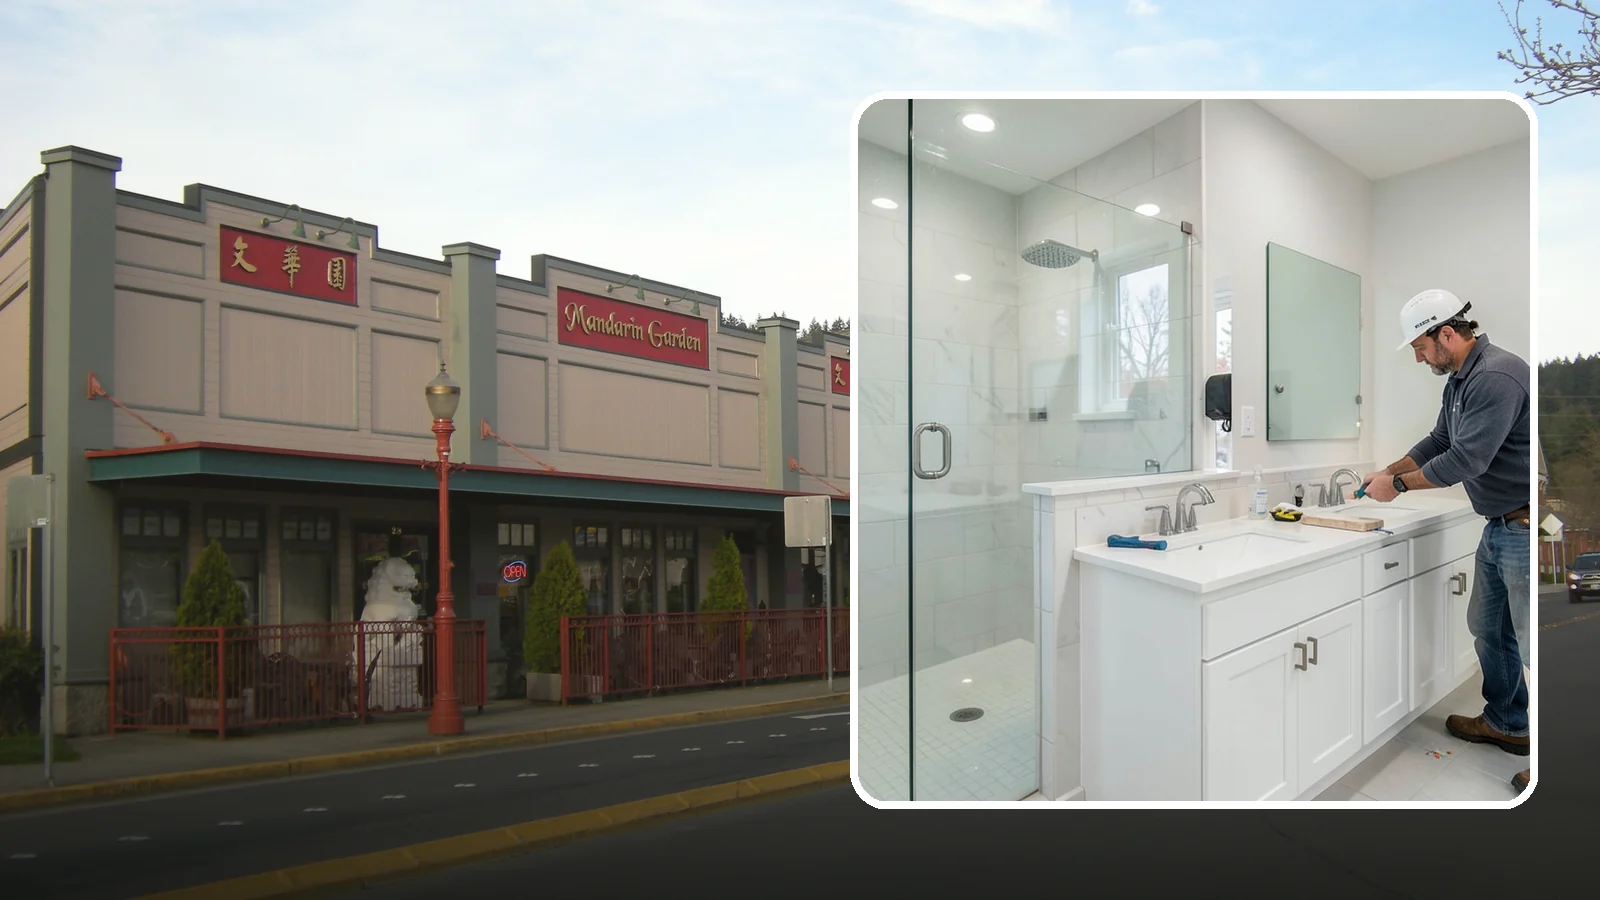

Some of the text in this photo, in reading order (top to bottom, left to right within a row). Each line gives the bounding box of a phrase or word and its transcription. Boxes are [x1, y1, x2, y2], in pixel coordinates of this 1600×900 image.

[230, 235, 346, 291] 文華園
[564, 302, 701, 352] Mandarin Garden
[503, 565, 527, 578] OPEN
